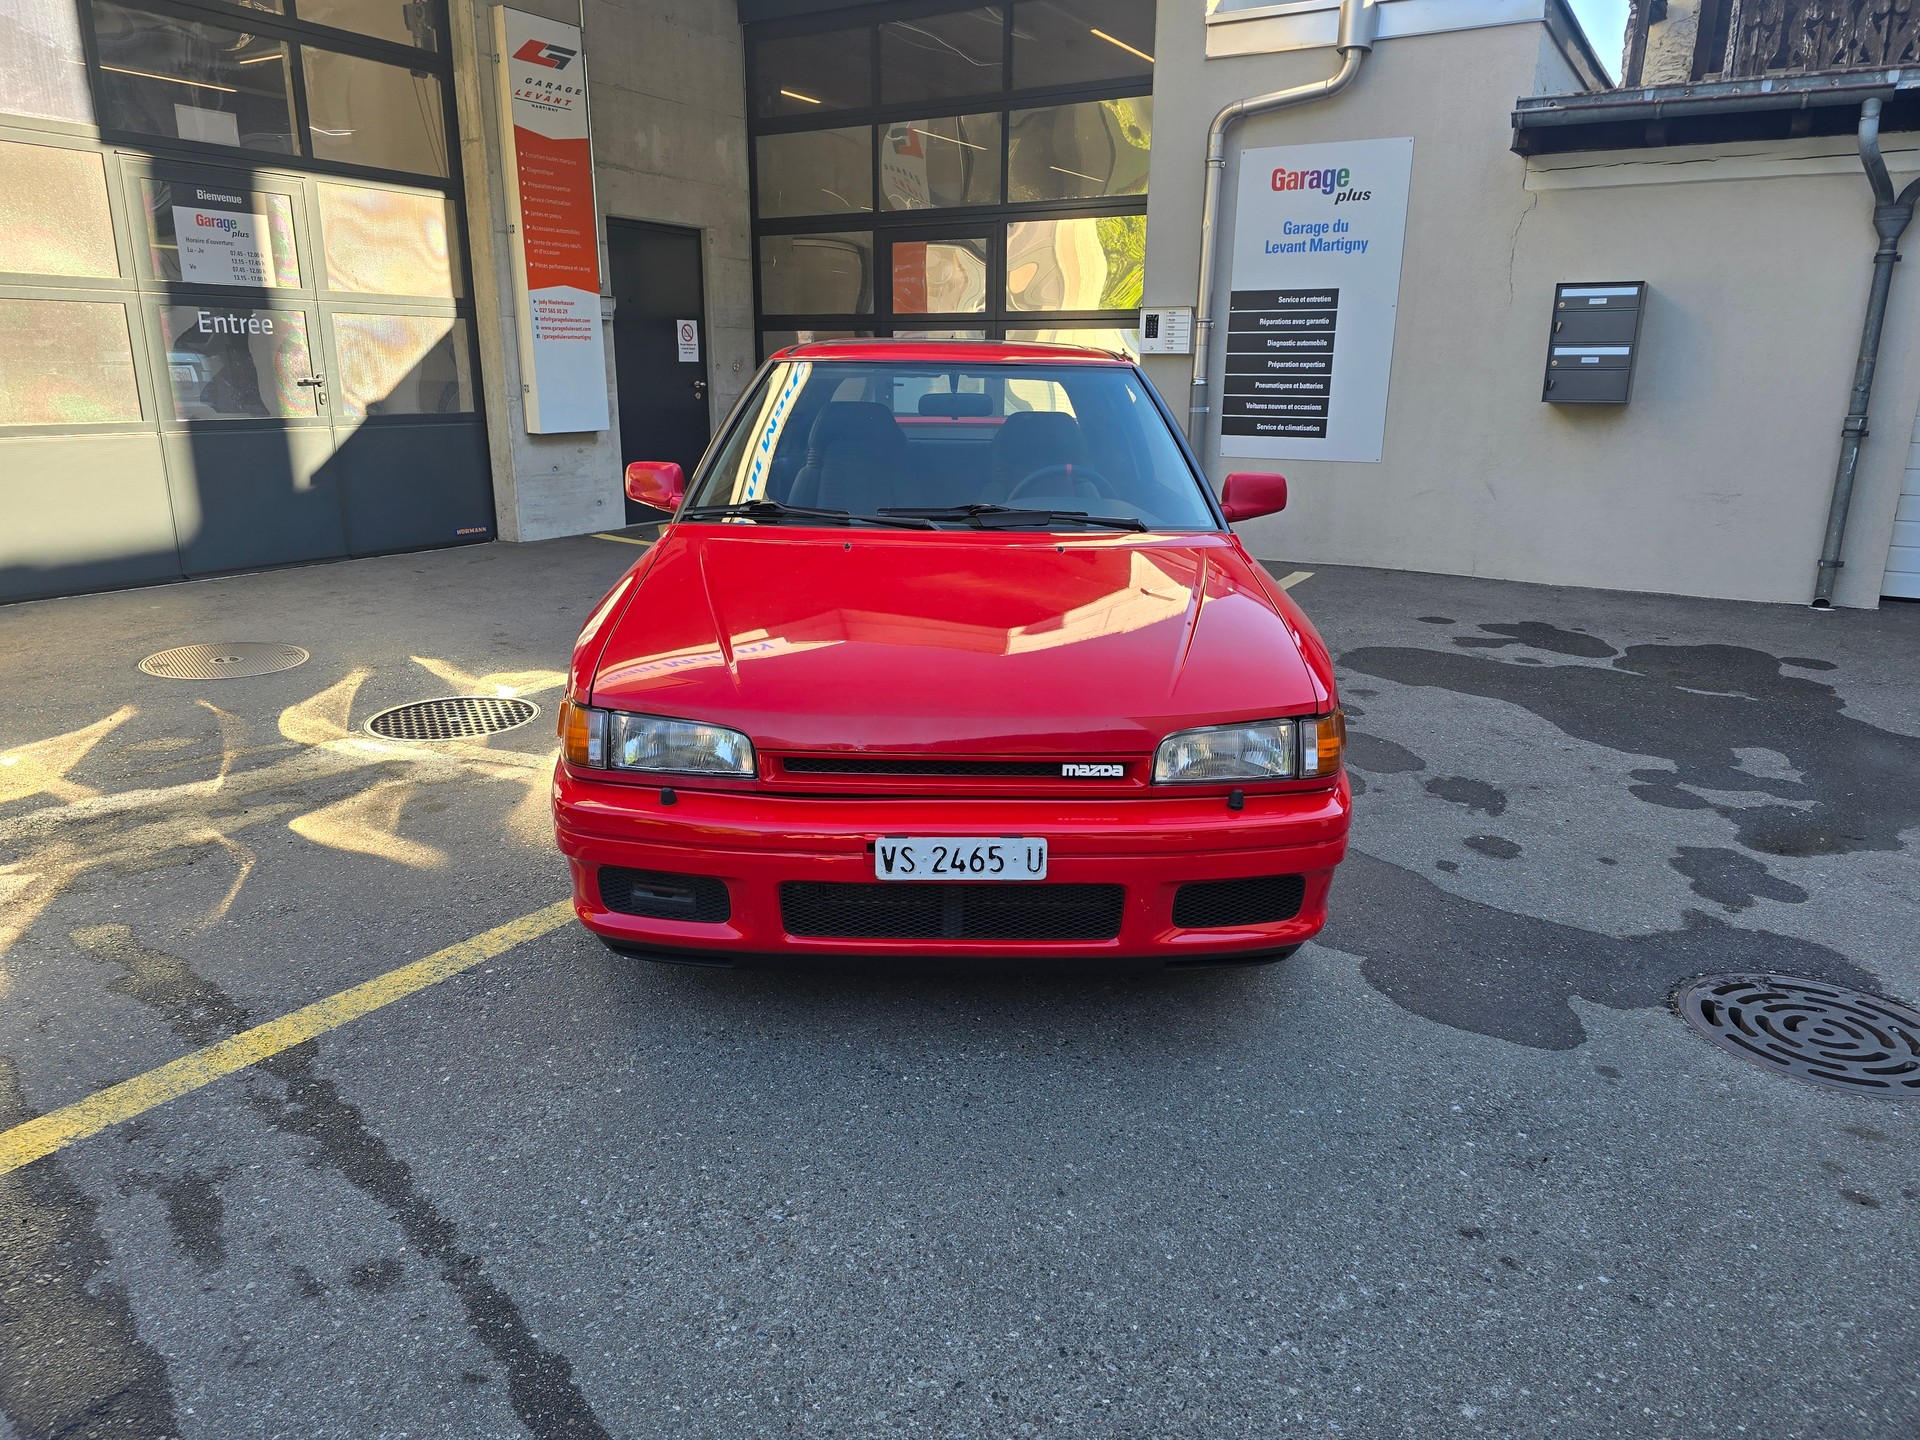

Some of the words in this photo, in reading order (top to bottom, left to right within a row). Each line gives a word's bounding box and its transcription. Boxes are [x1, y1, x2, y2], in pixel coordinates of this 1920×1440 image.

[525, 77, 582, 95] GARAGE
[515, 89, 572, 106] LEVANT
[1271, 168, 1350, 195] Garage
[196, 189, 242, 204] Bienvenue
[1334, 188, 1372, 205] plus
[195, 213, 237, 232] Garage
[1283, 221, 1329, 236] Garage
[1333, 219, 1349, 233] du
[231, 230, 250, 238] plus
[1265, 240, 1307, 254] Levant
[1309, 237, 1368, 254] Martigny
[197, 311, 274, 335] Entrée
[1259, 318, 1291, 326] Réparations
[1306, 317, 1329, 326] garantie
[1267, 339, 1296, 348] Diagnostic
[1297, 339, 1327, 347] automobile
[1268, 361, 1299, 369] Préparation
[1300, 361, 1325, 369] expertise
[1255, 382, 1292, 390] Pneumatiques
[1300, 382, 1323, 390] batteries
[1246, 402, 1267, 410] Voitures
[1285, 424, 1320, 432] climatisation
[1062, 764, 1124, 776] mazda
[881, 846, 915, 873] VS
[932, 846, 1004, 873] 2465
[1026, 846, 1044, 873] U
